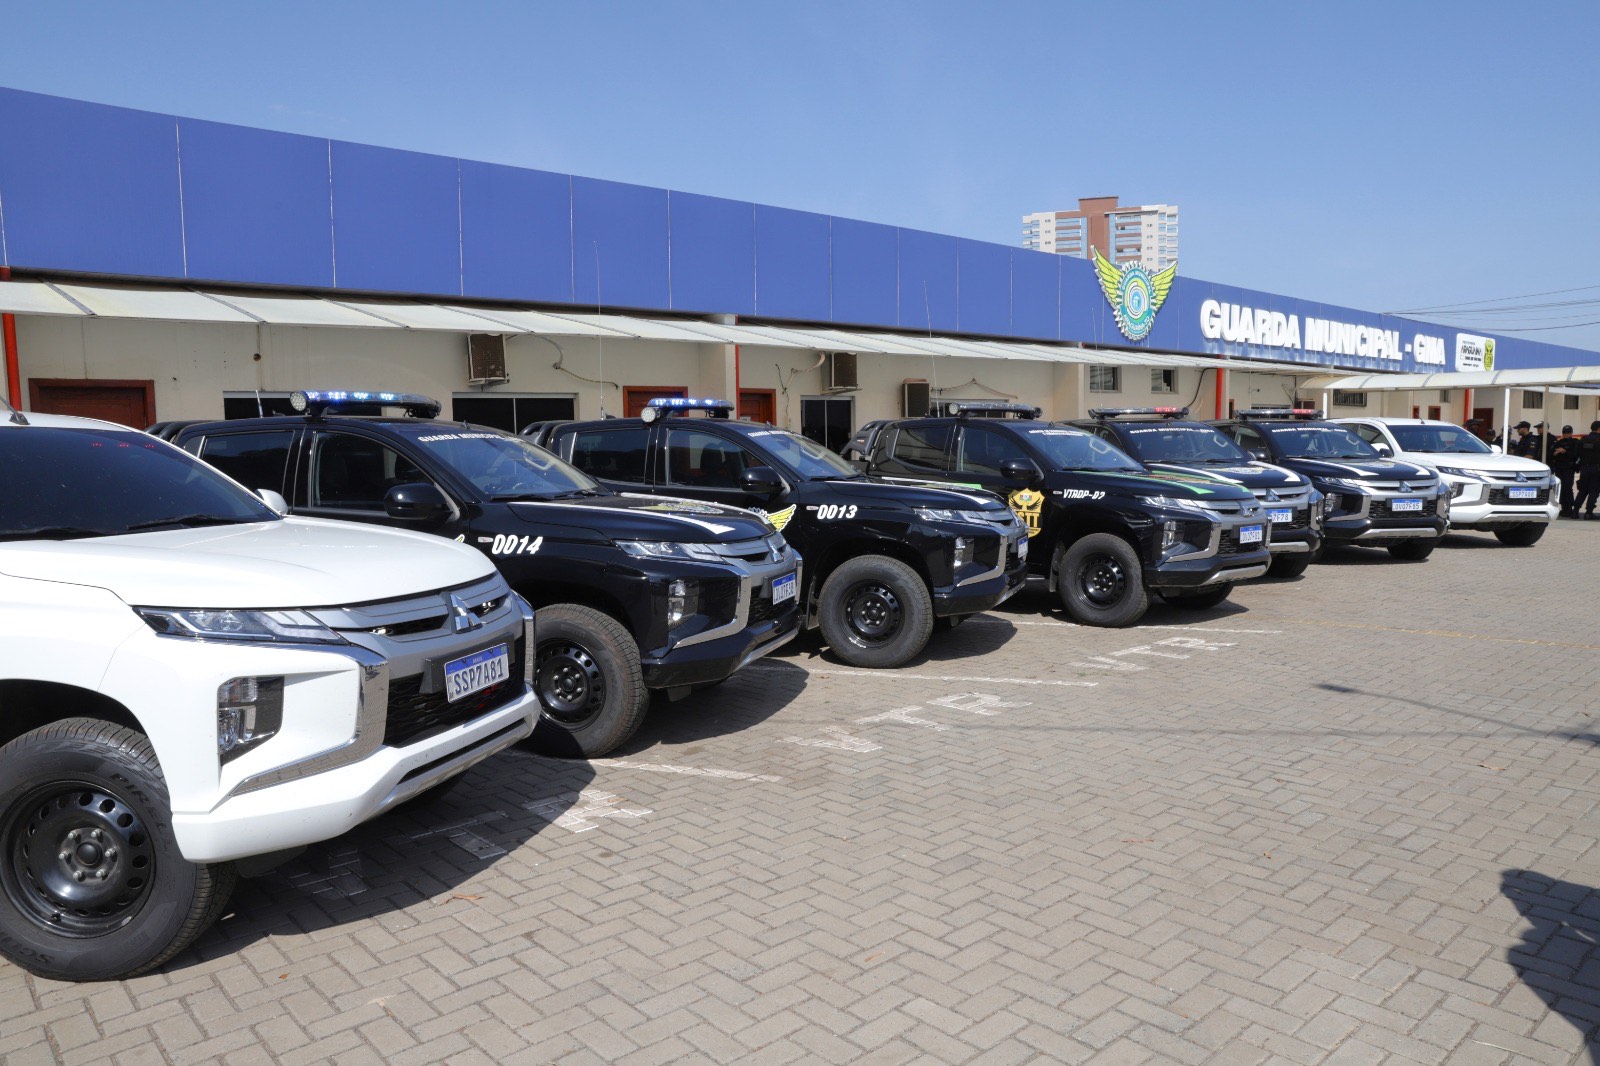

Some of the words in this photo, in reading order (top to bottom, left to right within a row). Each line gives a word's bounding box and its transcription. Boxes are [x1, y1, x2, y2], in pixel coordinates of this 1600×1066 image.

[1200, 299, 1301, 349] GUARDA
[1304, 317, 1402, 360] MUNICIPAL
[1413, 333, 1445, 365] GMA
[418, 433, 460, 442] GUARDA
[817, 504, 858, 519] 0013
[1272, 513, 1289, 521] 7F78
[492, 533, 544, 555] 0014
[453, 658, 504, 695] SSP7A81
